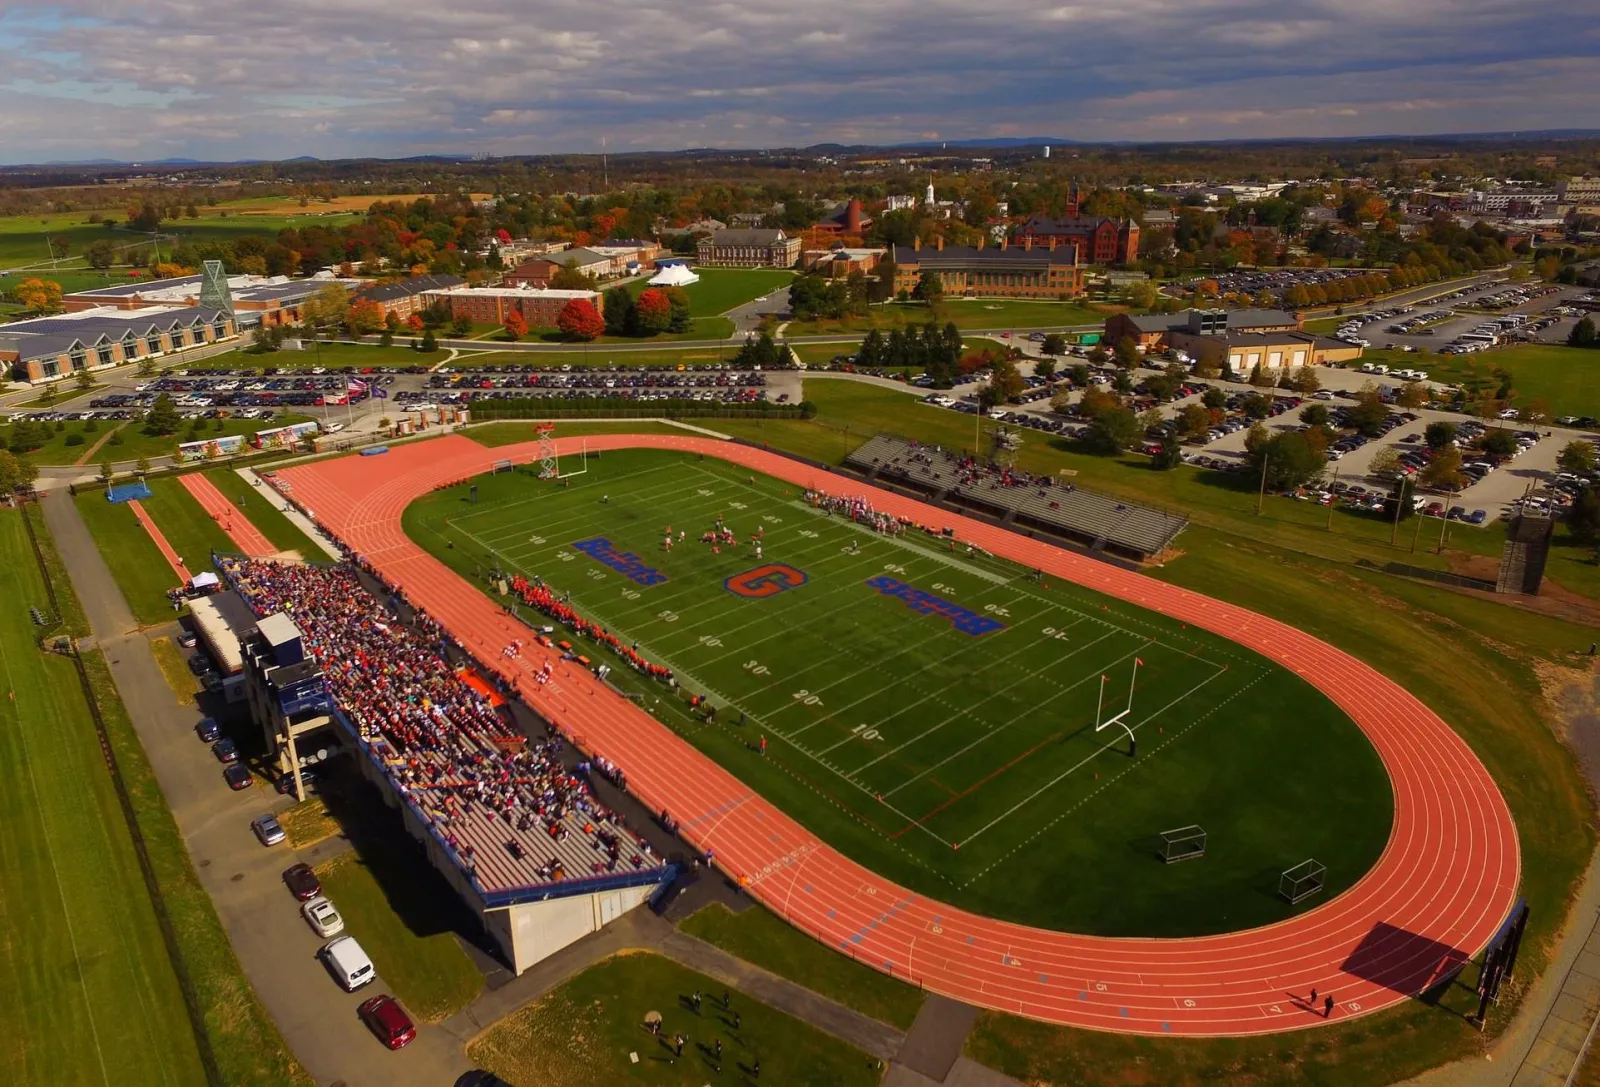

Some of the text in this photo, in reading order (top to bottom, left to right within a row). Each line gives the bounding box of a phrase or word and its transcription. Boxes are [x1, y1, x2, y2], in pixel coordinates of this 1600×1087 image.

[722, 563, 808, 598] G
[931, 583, 952, 594] 30
[657, 610, 679, 622] 50
[984, 604, 1008, 616] 20
[1042, 627, 1066, 640] 10
[698, 635, 719, 647] 40
[742, 660, 767, 675] 30
[792, 689, 820, 706] 20
[851, 724, 879, 740] 10
[1010, 958, 1021, 966] 4
[1096, 983, 1108, 991] 5
[1184, 998, 1197, 1008] 6
[1349, 1002, 1361, 1012] 8
[1269, 1005, 1283, 1014] 7
